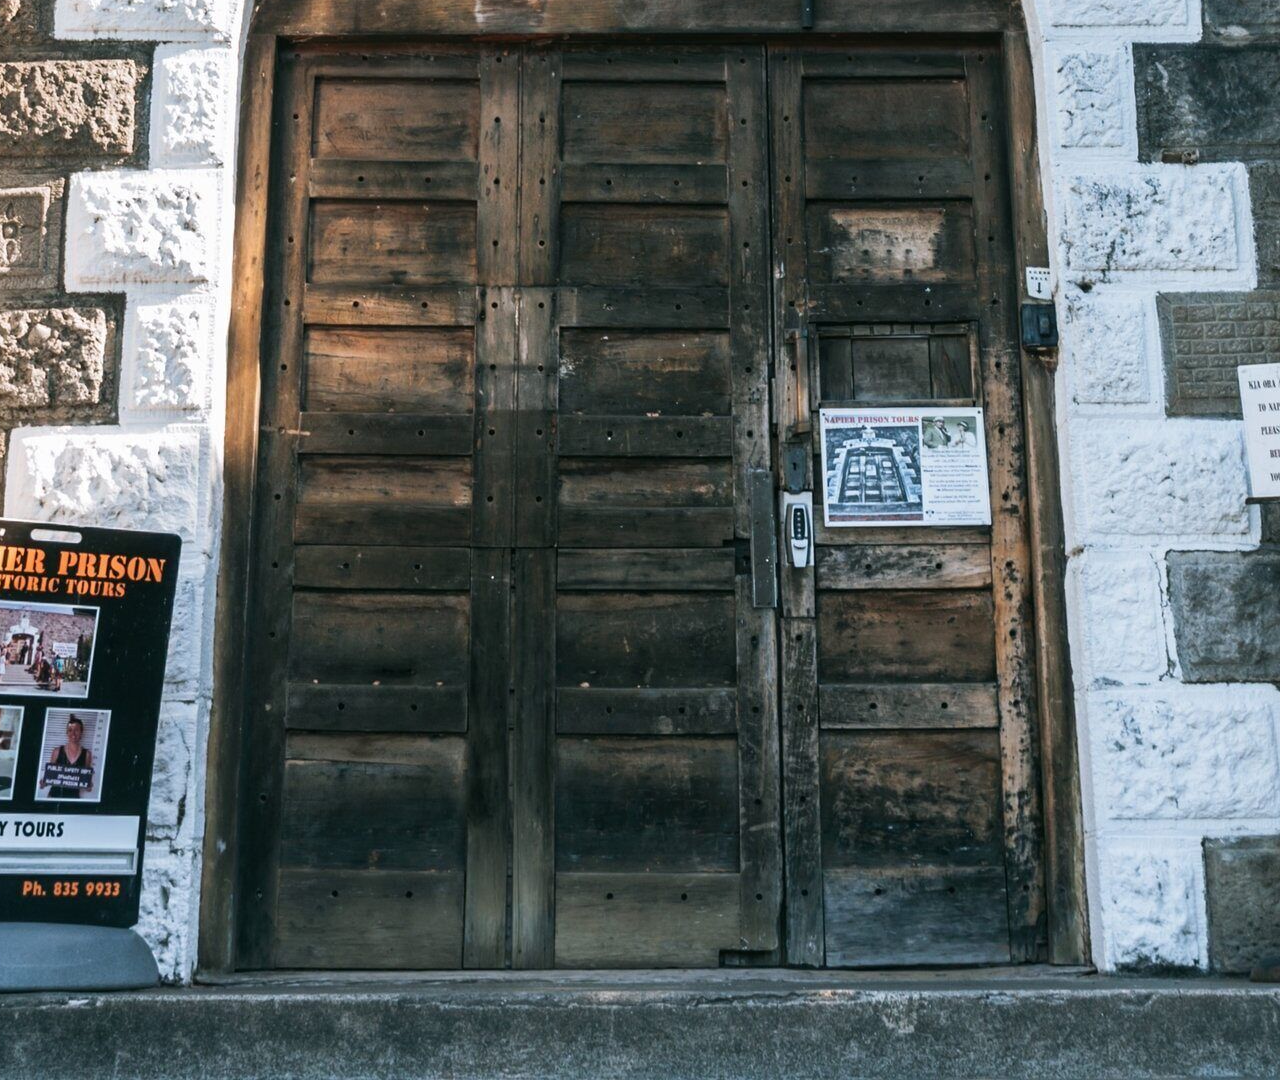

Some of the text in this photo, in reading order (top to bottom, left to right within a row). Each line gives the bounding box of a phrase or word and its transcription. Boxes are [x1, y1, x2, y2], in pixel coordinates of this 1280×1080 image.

[1248, 380, 1261, 389] KIA
[1263, 379, 1276, 389] ORA
[1258, 403, 1267, 412] TO
[824, 416, 855, 424] NAPIER
[857, 416, 889, 424] PRISON
[57, 550, 166, 583] PRISON
[65, 578, 126, 598] TOURS
[14, 821, 64, 838] TOURS
[22, 881, 120, 897] Ph. 835 9933
